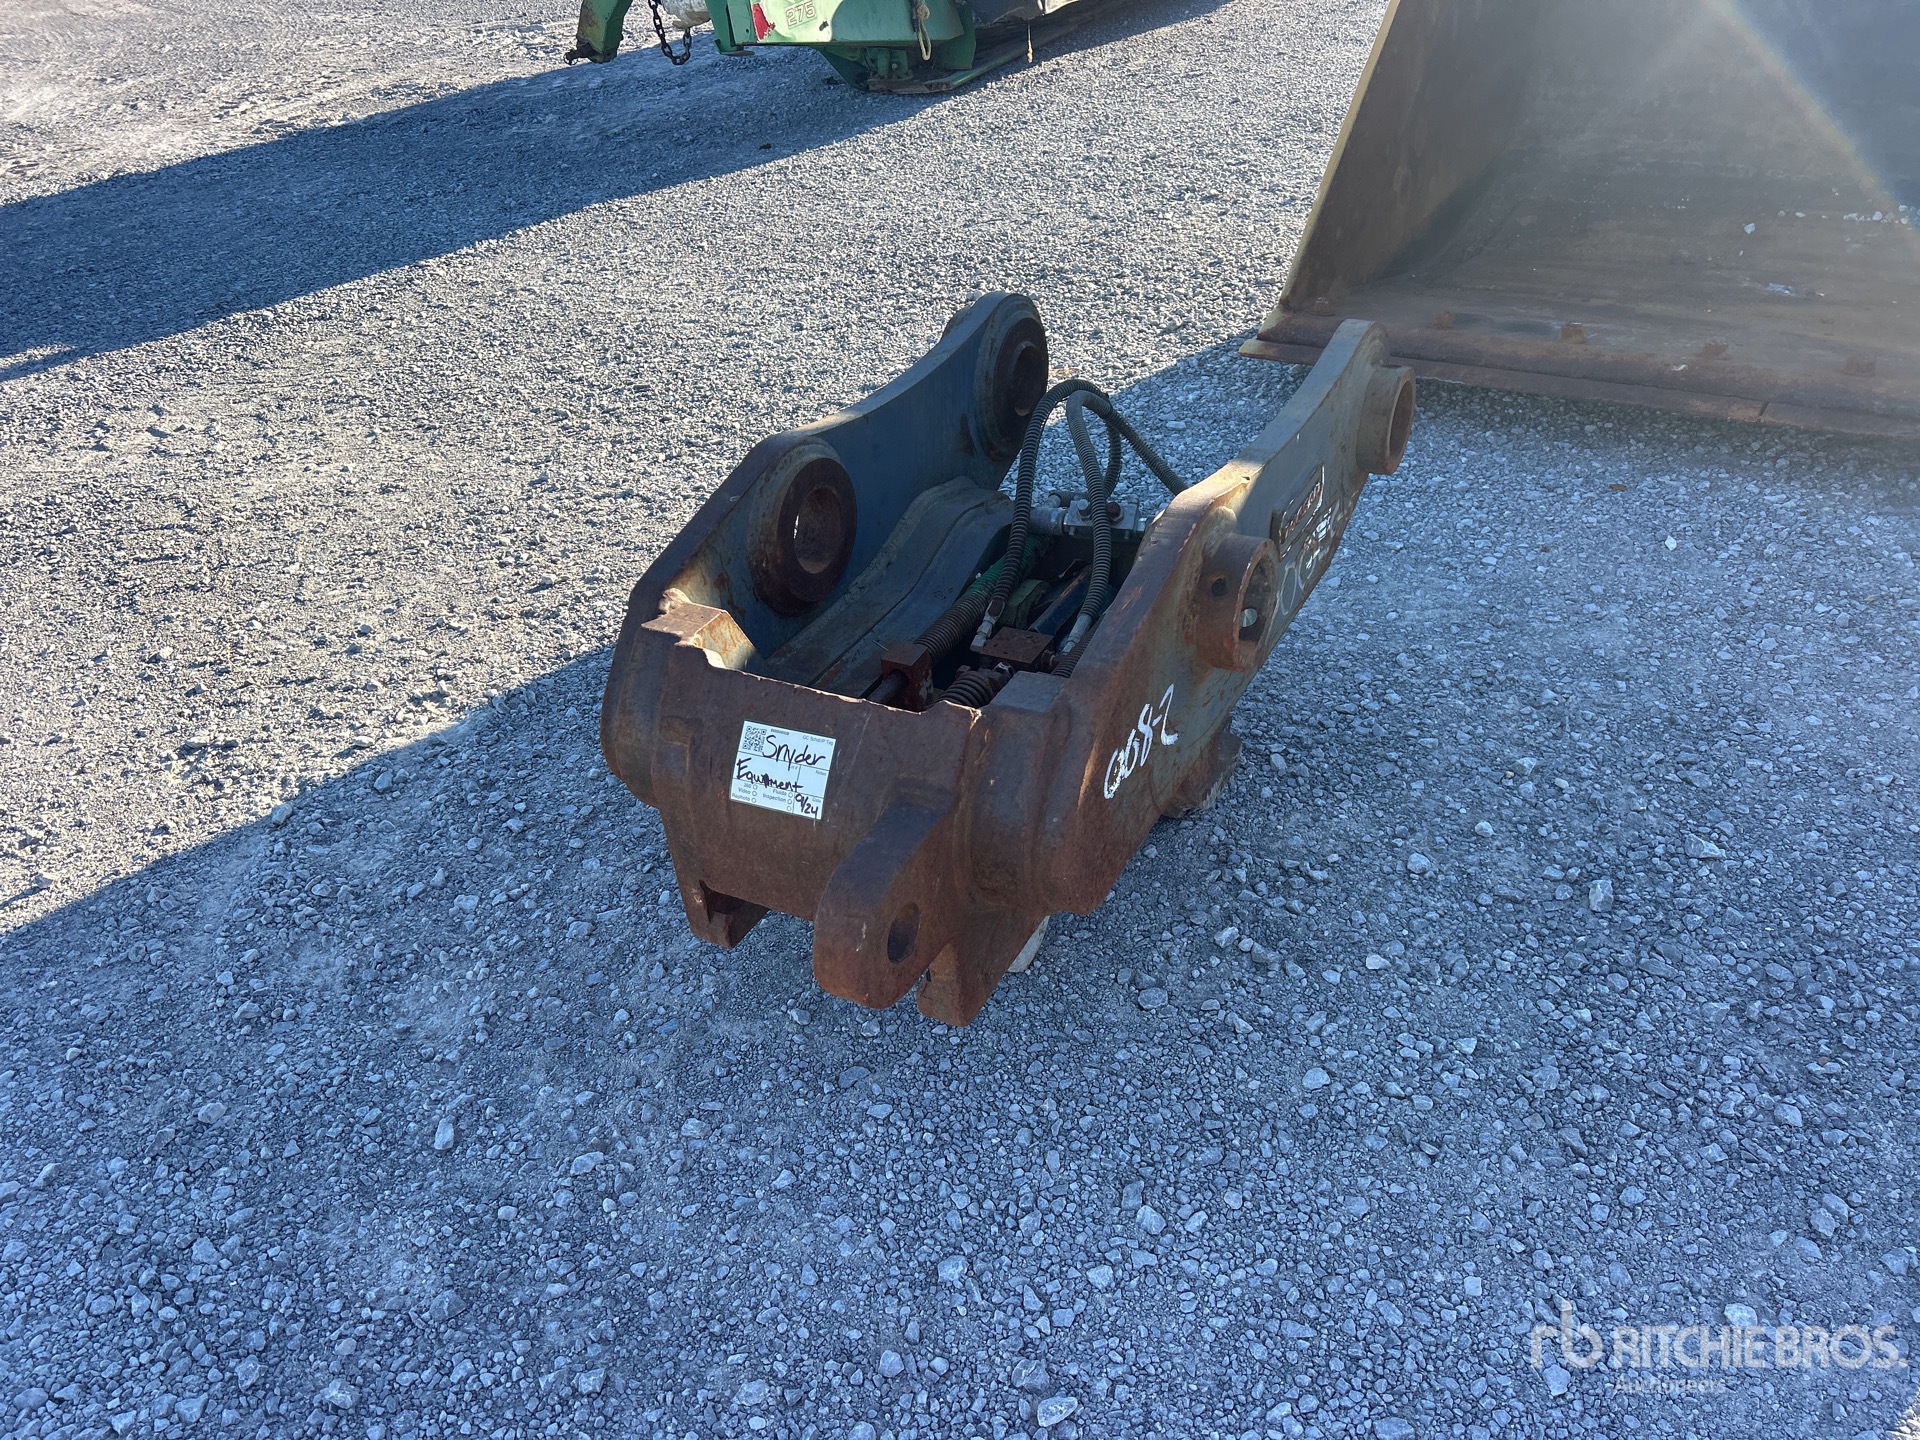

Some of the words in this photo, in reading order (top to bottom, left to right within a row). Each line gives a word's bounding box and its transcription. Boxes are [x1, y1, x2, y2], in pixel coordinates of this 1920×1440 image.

[786, 1, 816, 27] 275
[761, 734, 826, 771] Snyder
[738, 787, 751, 795] Video
[772, 788, 787, 796] Fluids
[762, 793, 787, 803] Inspection
